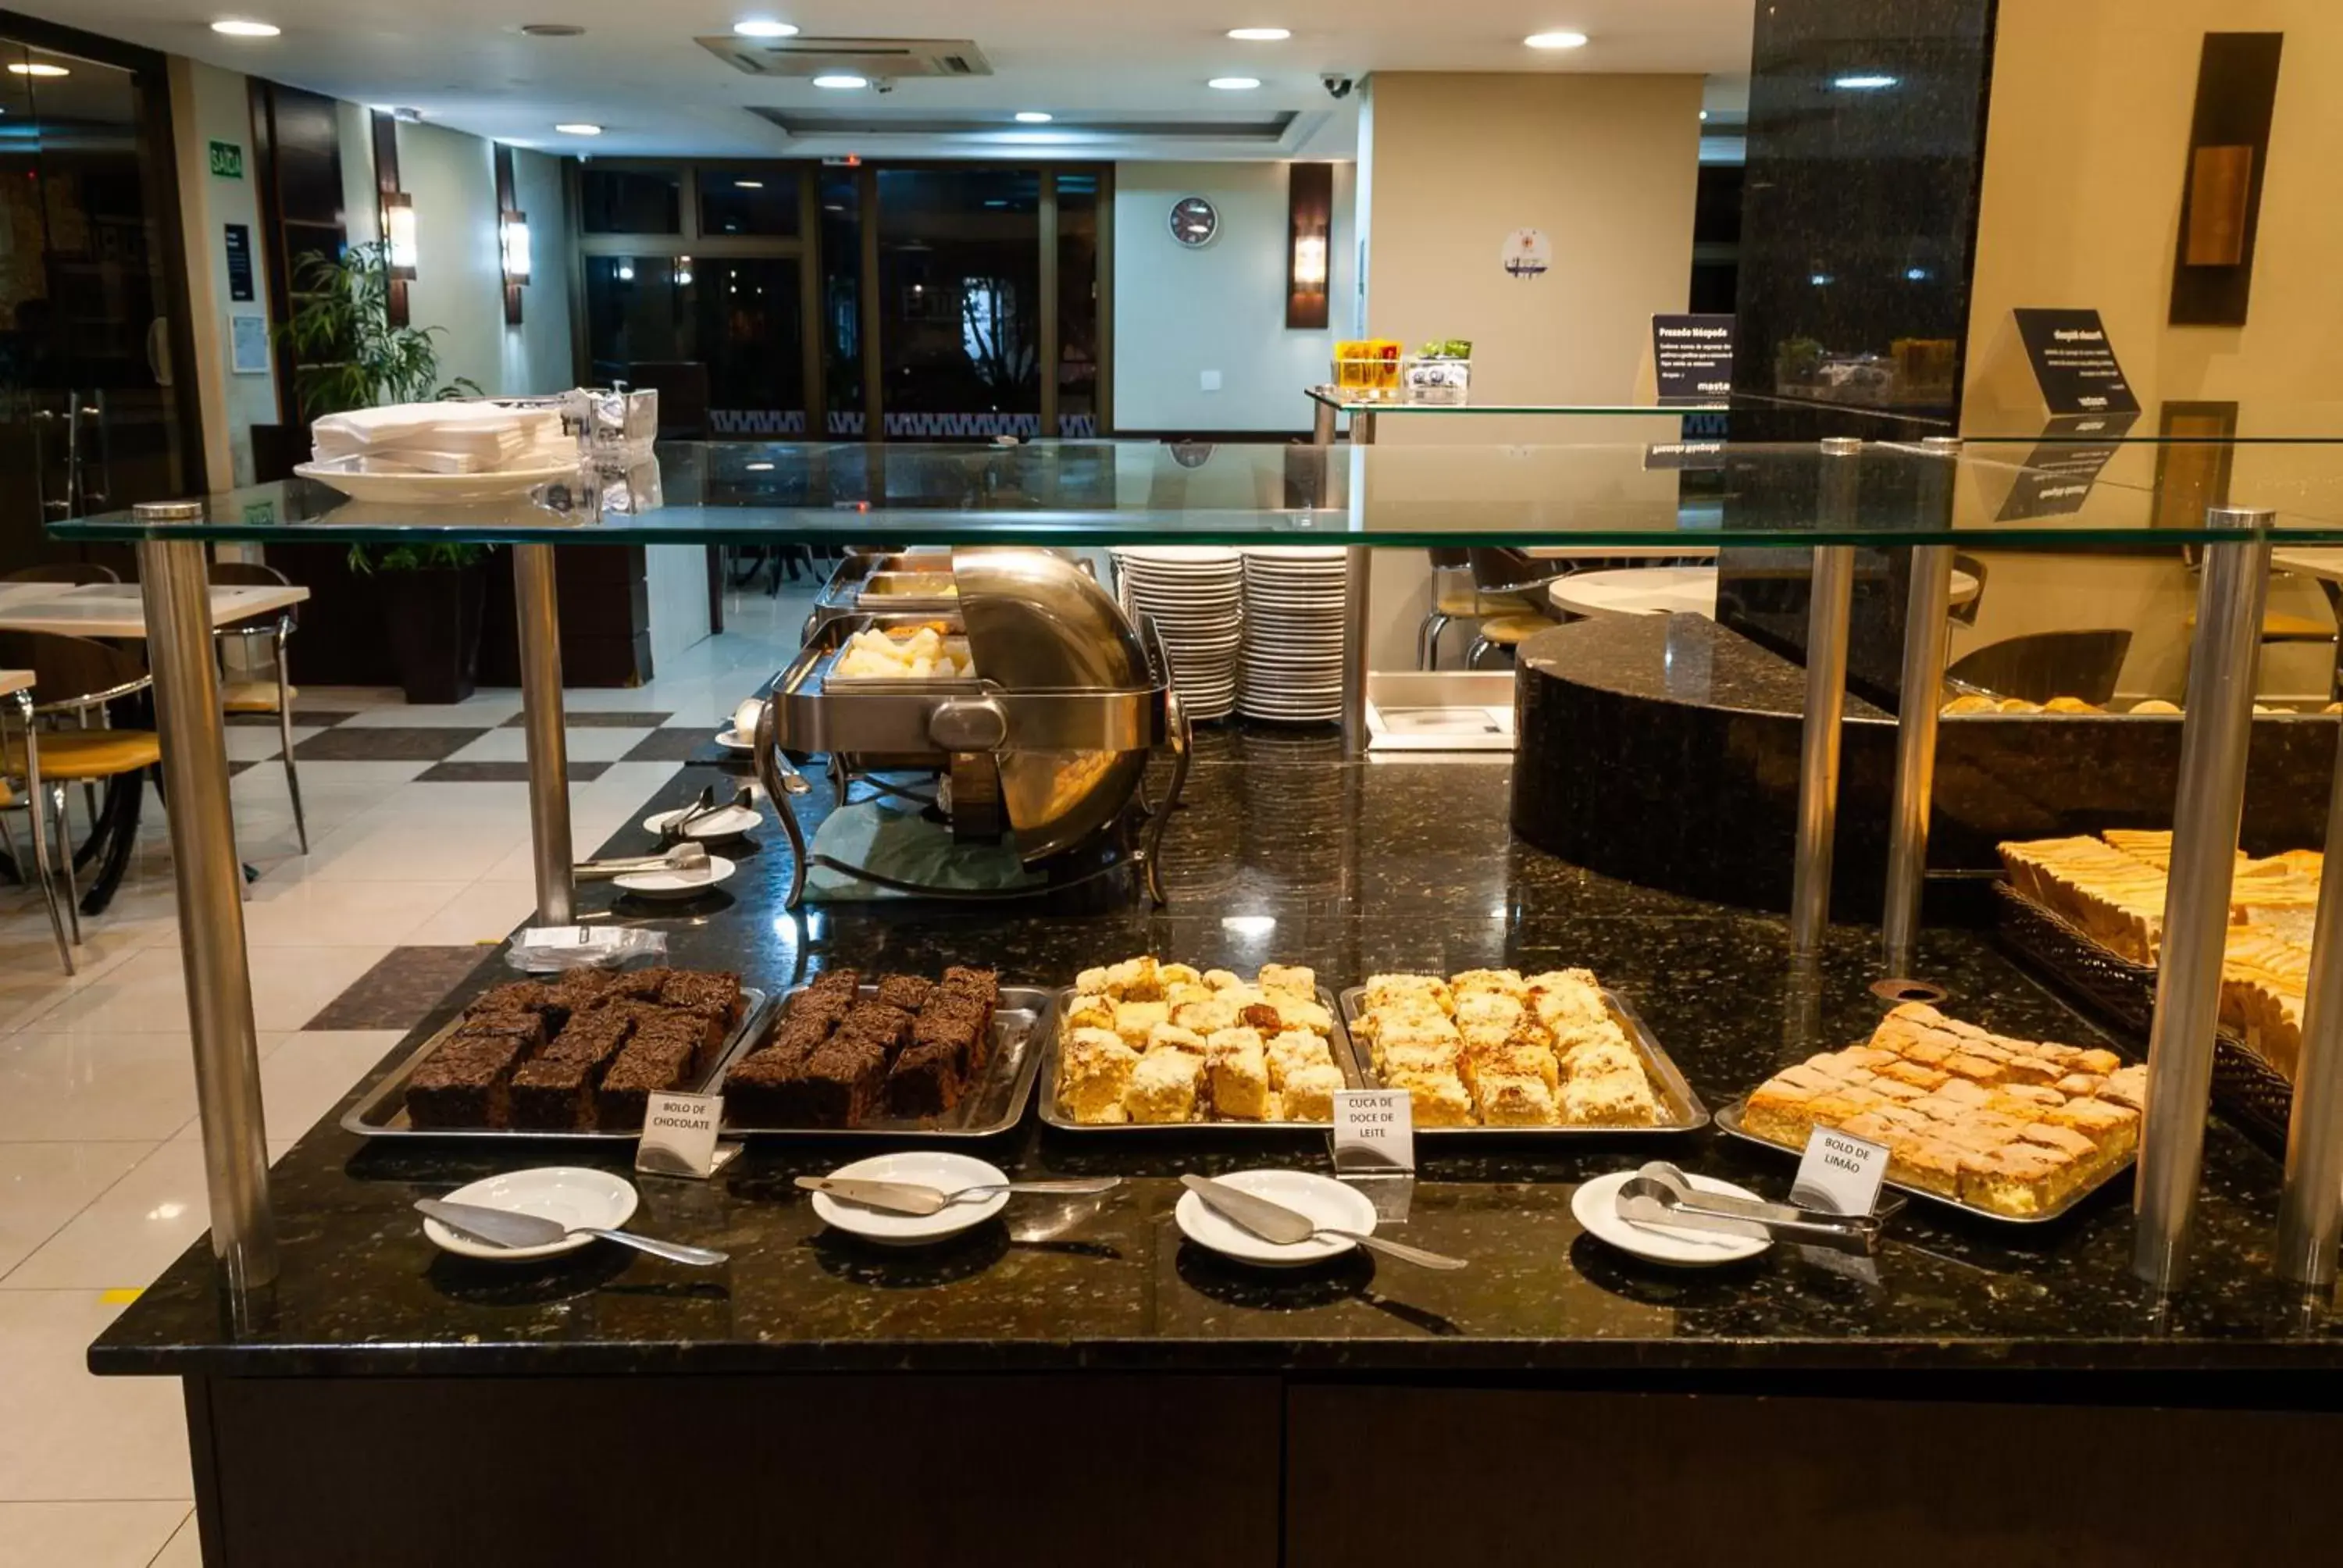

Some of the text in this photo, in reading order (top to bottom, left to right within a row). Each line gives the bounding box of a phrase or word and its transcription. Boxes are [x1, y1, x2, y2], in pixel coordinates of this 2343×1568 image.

[663, 1102, 706, 1114] BOLO DE
[1349, 1098, 1393, 1108] CUCA DE
[653, 1117, 710, 1130] CHOCOLATE
[1350, 1113, 1394, 1122] DOCE DE
[1360, 1128, 1385, 1138] LEITE
[1824, 1137, 1870, 1161] BOLO DE
[1824, 1153, 1860, 1174] LIMÃO
